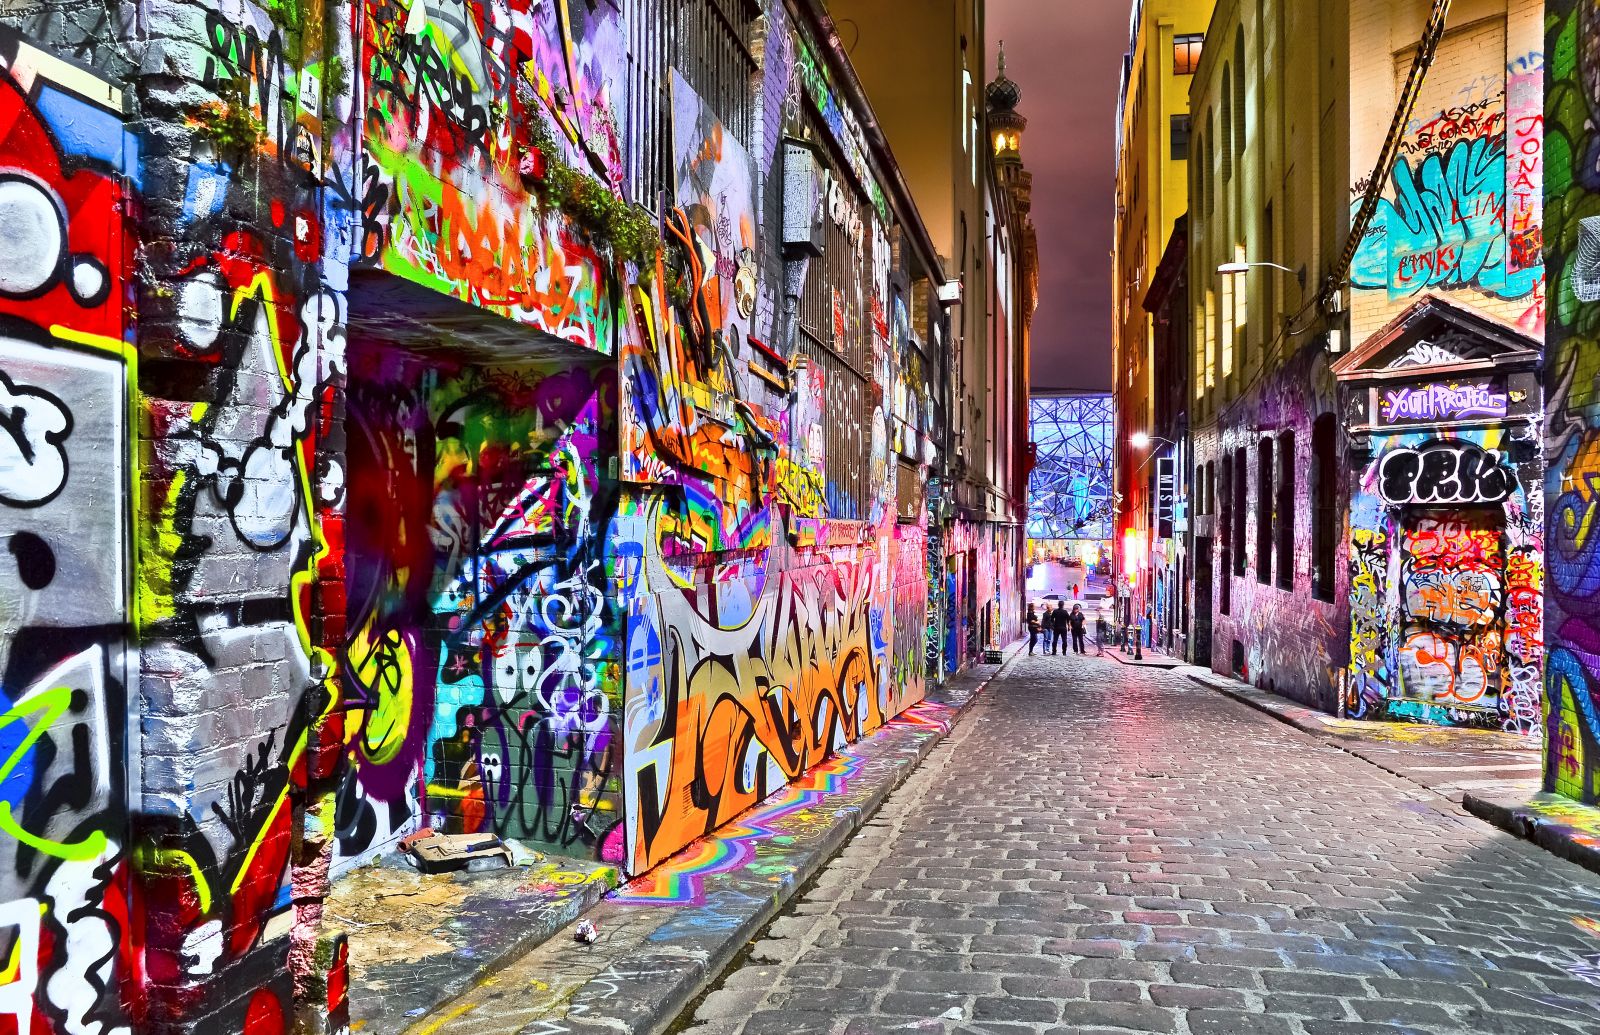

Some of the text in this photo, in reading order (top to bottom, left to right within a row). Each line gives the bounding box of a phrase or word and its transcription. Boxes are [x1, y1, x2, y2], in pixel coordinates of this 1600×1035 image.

[1386, 383, 1507, 421] YOUTH PROJECT
[1160, 474, 1173, 522] MISTY
